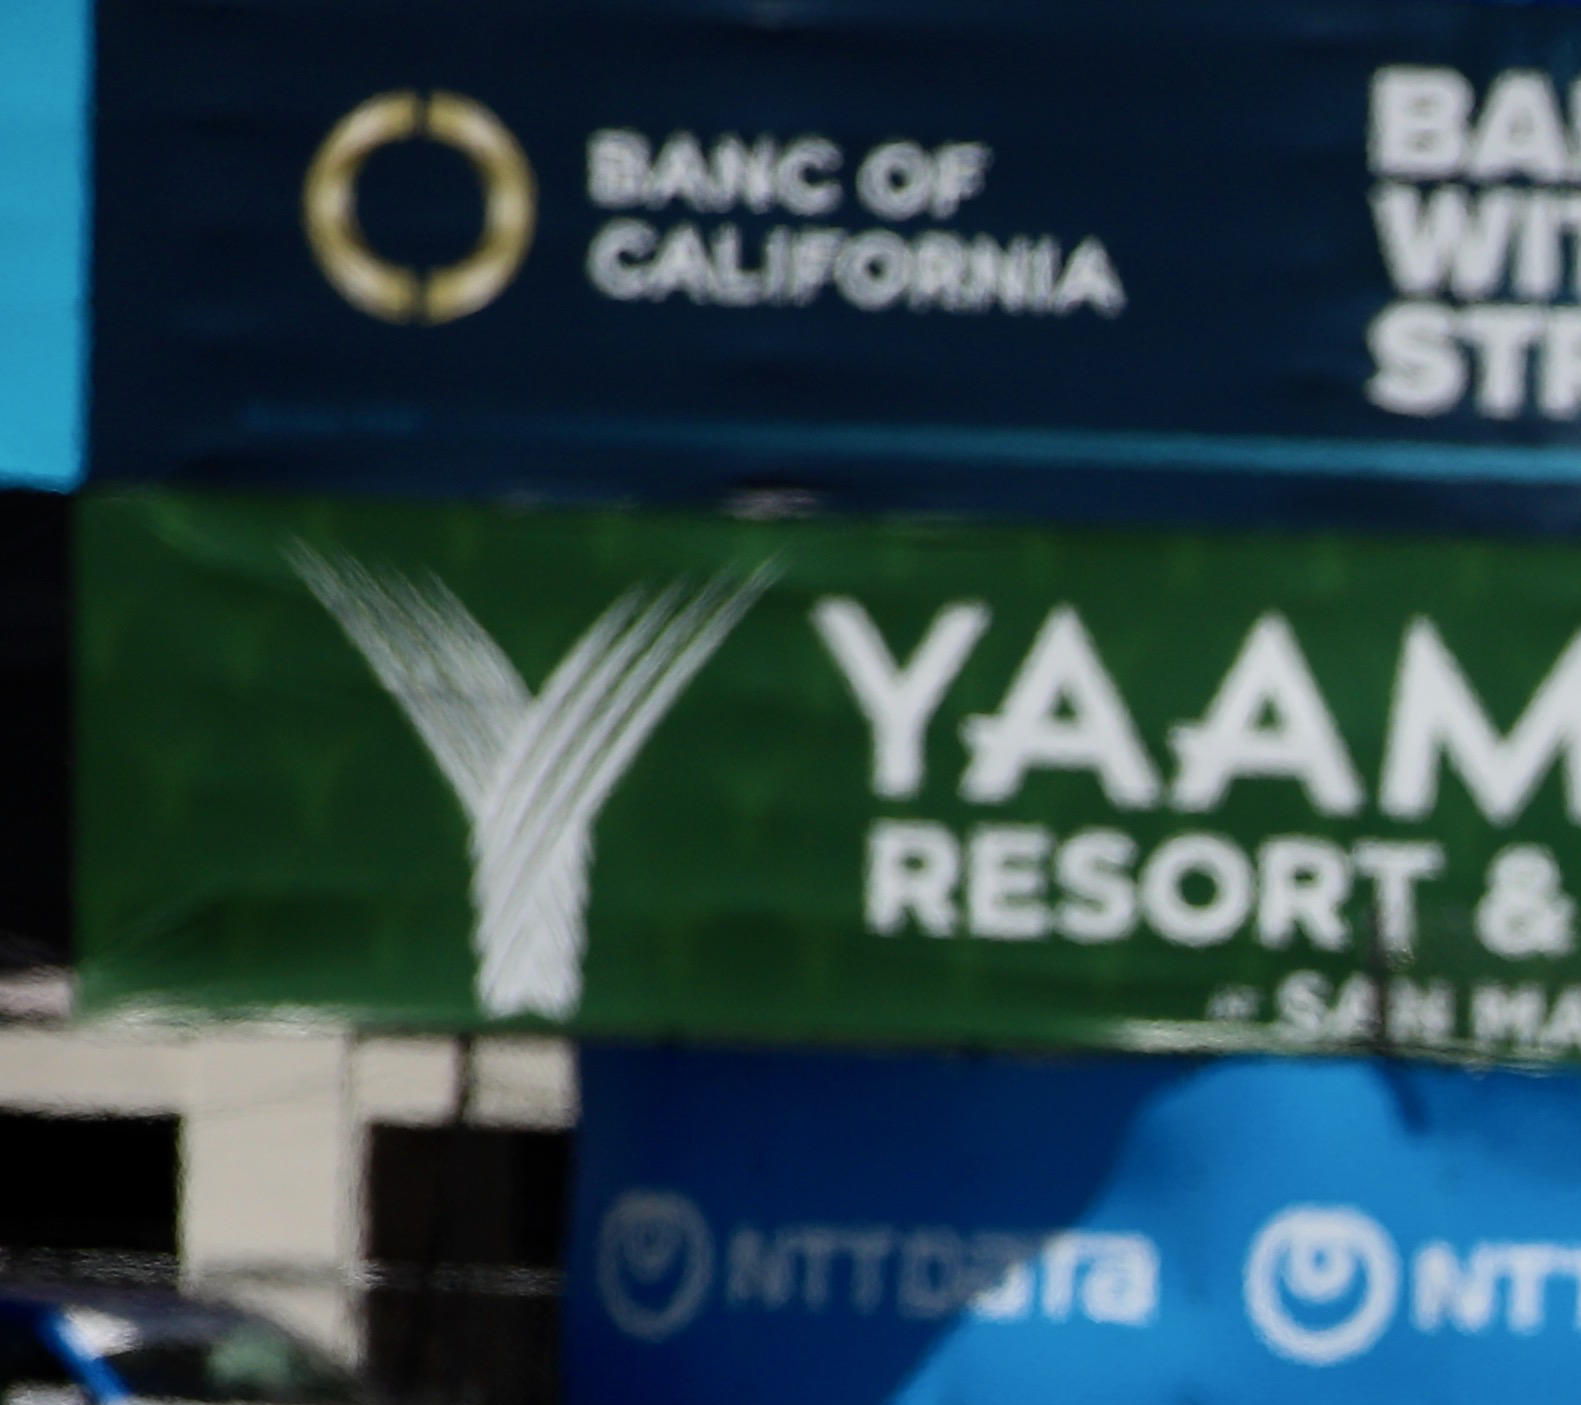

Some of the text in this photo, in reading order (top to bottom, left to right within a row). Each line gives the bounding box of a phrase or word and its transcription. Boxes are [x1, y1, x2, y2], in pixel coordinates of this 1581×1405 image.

[587, 128, 993, 220] BANC OF
[585, 215, 1127, 316] CALIFORNIA
[866, 816, 1444, 951] RESORT
[1477, 845, 1576, 959] &
[1276, 970, 1455, 1044] SAN
[725, 1228, 884, 1313] NTT
